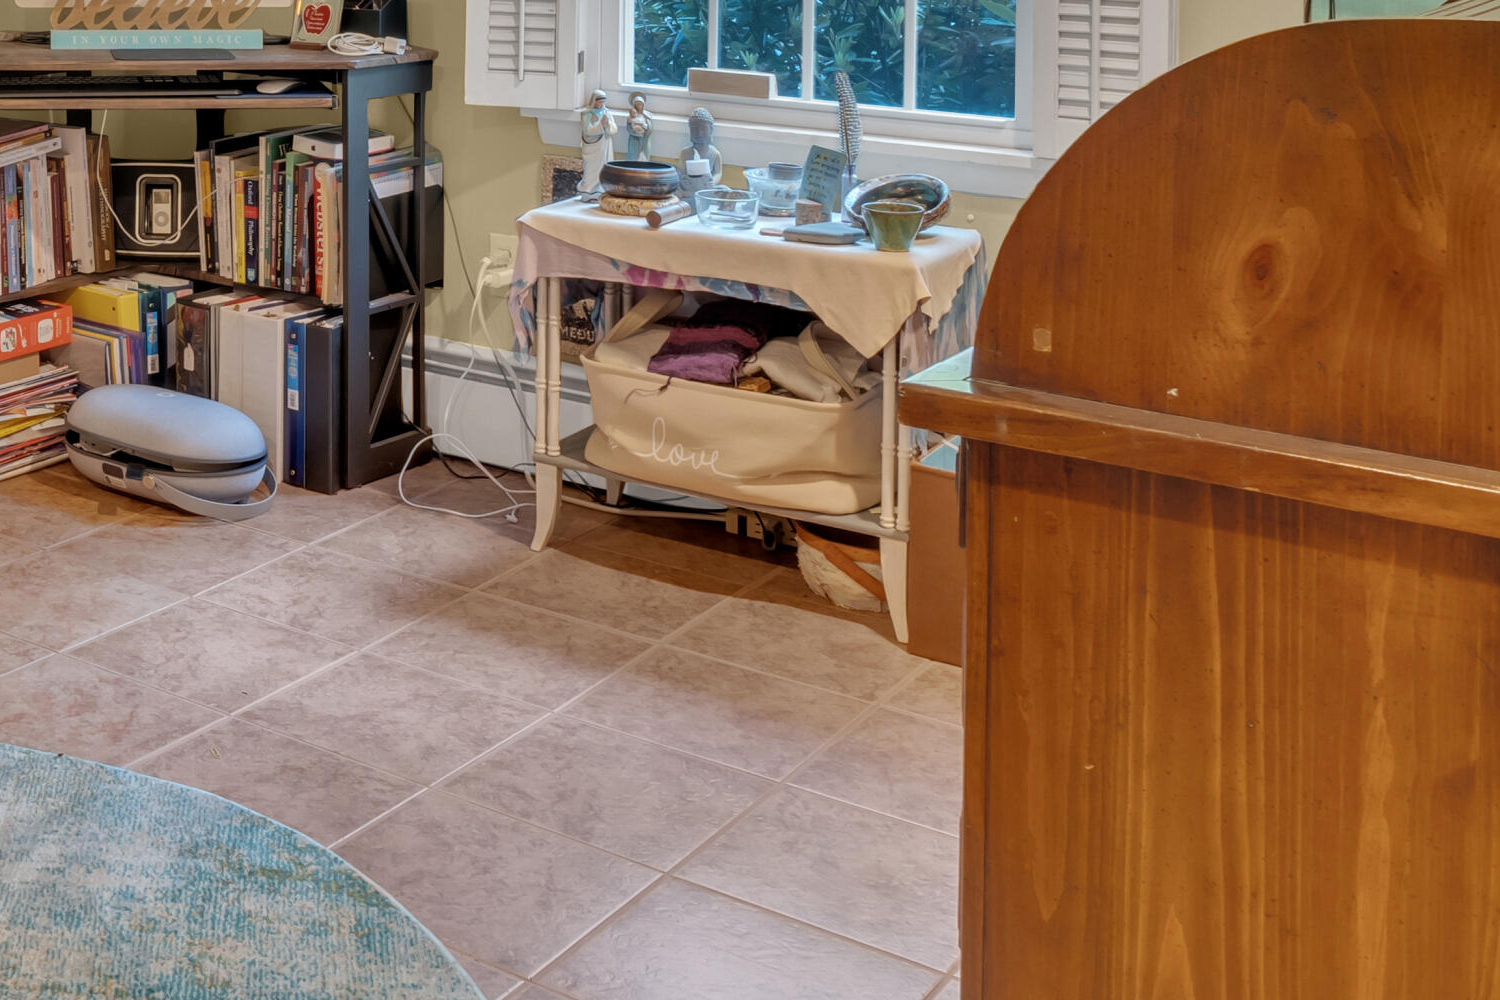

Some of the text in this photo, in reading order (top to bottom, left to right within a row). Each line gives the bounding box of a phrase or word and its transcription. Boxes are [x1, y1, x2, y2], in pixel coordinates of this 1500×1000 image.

[71, 34, 243, 45] IN YOUR OWN MAGIC
[246, 220, 254, 255] Philosophy
[640, 416, 726, 475] love
